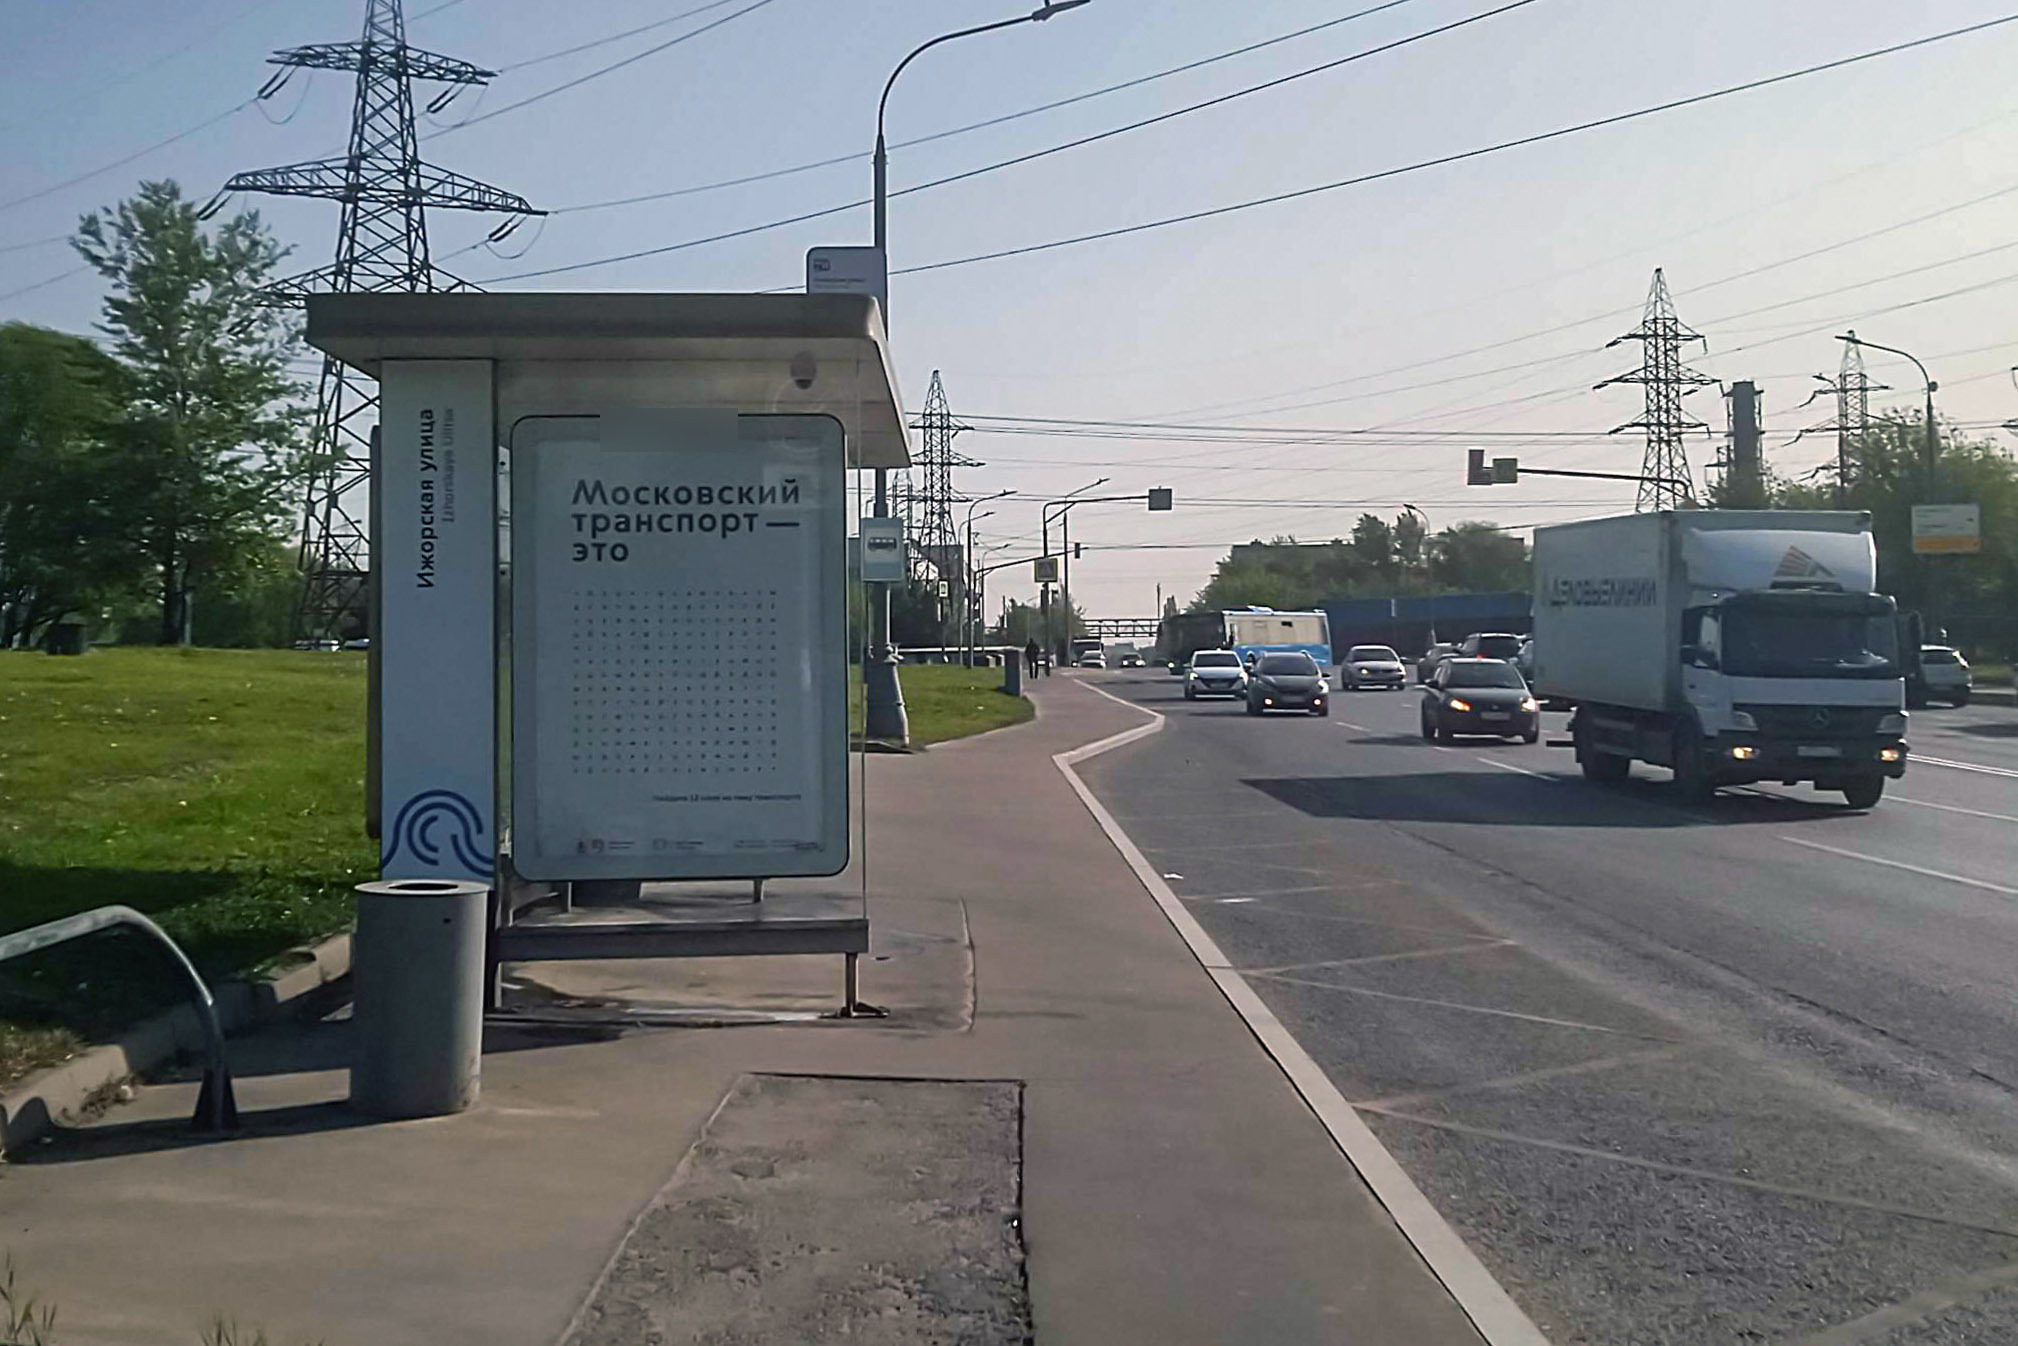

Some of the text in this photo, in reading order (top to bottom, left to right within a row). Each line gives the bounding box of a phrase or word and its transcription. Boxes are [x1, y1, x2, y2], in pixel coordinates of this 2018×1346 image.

[416, 409, 438, 588] Ижорская улица
[571, 478, 800, 506] Московский
[571, 512, 759, 539] транспорт
[571, 541, 630, 563] это
